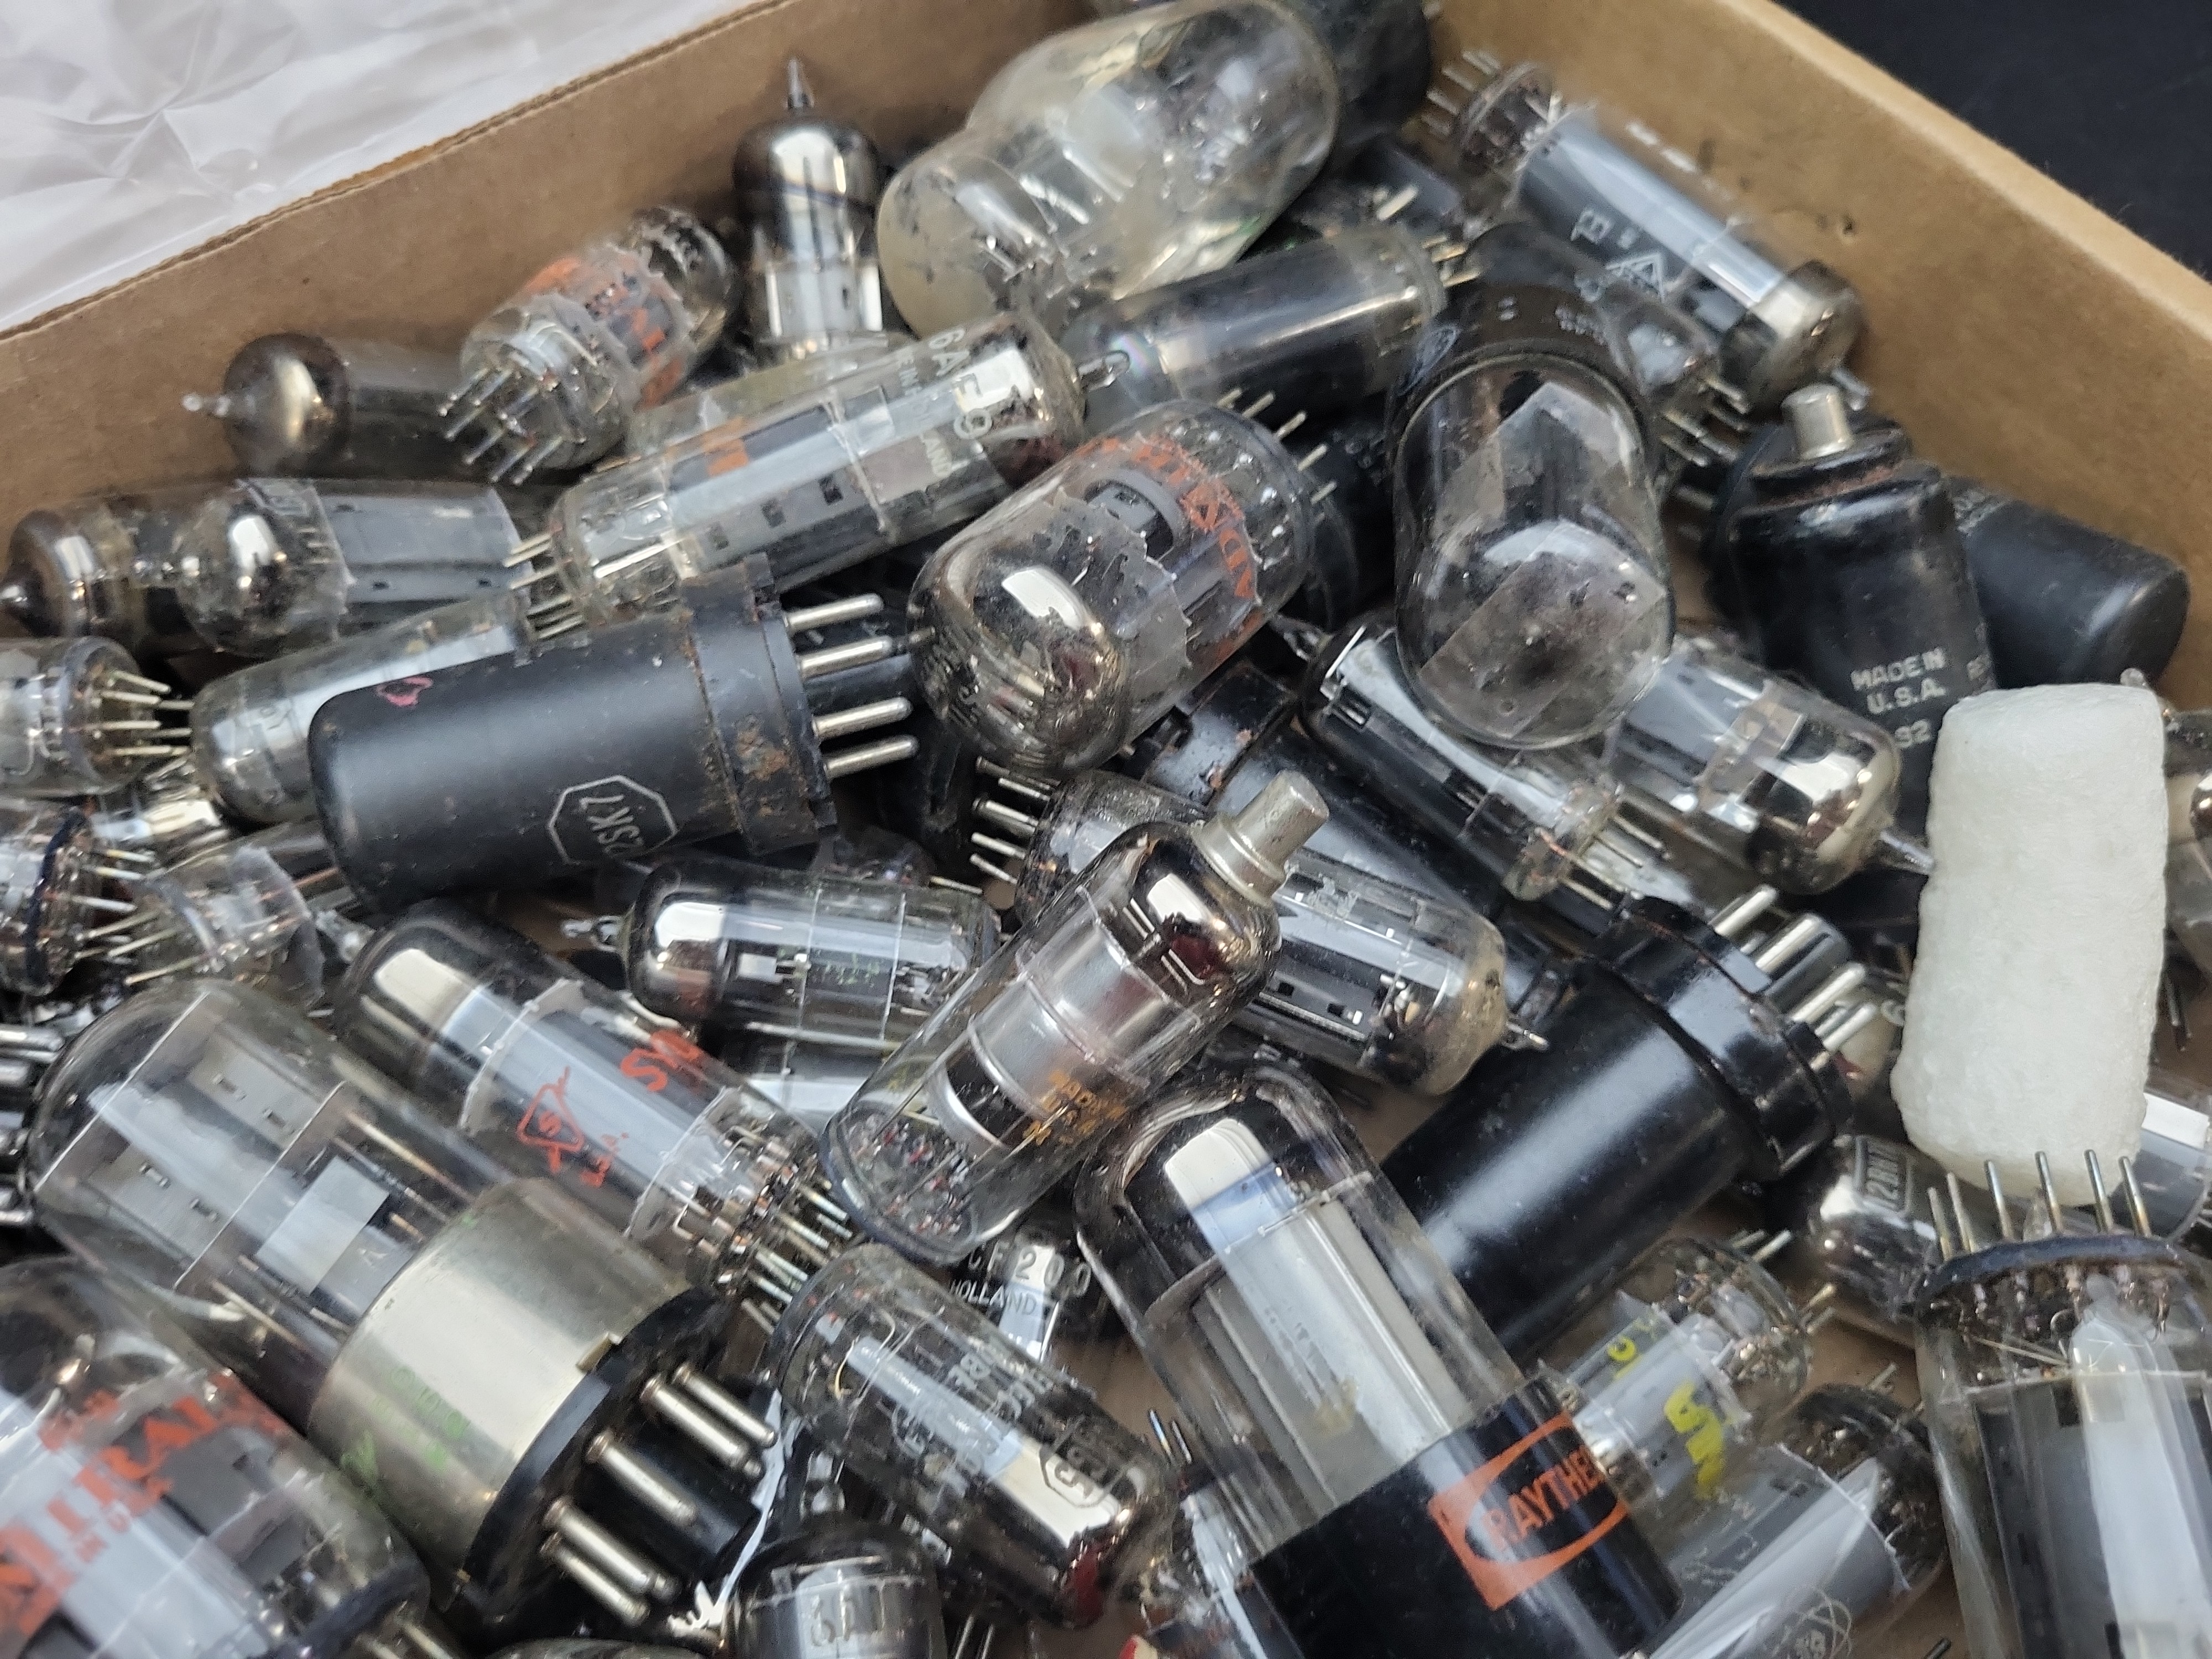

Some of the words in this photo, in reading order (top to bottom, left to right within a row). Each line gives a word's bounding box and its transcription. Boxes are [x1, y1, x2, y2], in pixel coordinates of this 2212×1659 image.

[1851, 654, 1923, 690] MADE
[1920, 646, 1947, 675] IN
[950, 1279, 1037, 1315] HOLLAND
